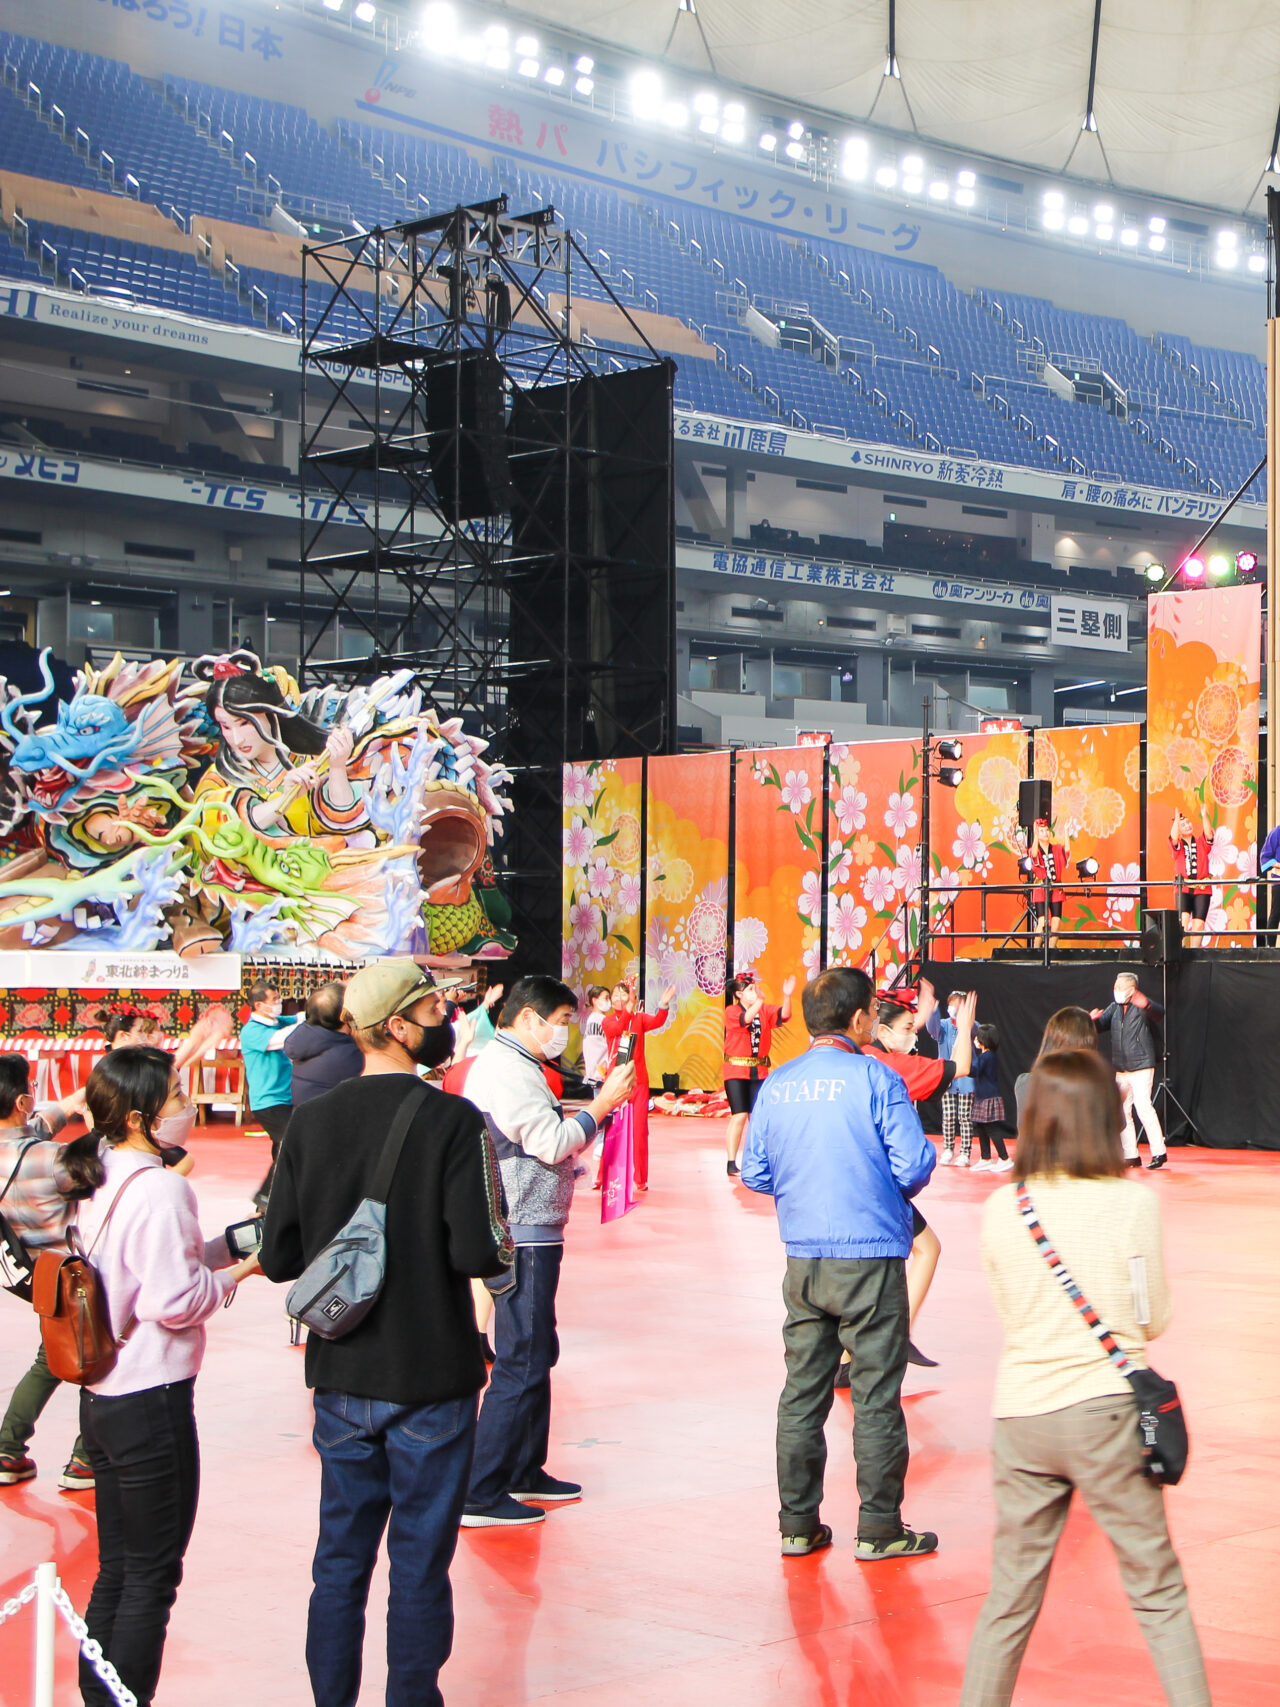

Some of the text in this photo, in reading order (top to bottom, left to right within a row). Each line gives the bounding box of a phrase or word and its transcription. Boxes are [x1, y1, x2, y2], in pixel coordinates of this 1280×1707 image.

[596, 139, 922, 252] パシフィック・リーグ
[50, 303, 109, 327] Realize
[112, 317, 150, 335] your
[152, 322, 210, 346] dreams
[673, 419, 788, 456] る会社 鹿島
[864, 453, 1004, 489] SHINRYO 新菱冷熱
[205, 482, 267, 512] TCS
[1157, 496, 1223, 520] バンテリン
[713, 552, 896, 592] 電協通信工業株式会社
[949, 585, 1014, 604] 奥アンツーカ
[1056, 608, 1122, 640] 三塁側
[106, 964, 182, 979] 東北絆まつり
[769, 1079, 845, 1105] STAFF
